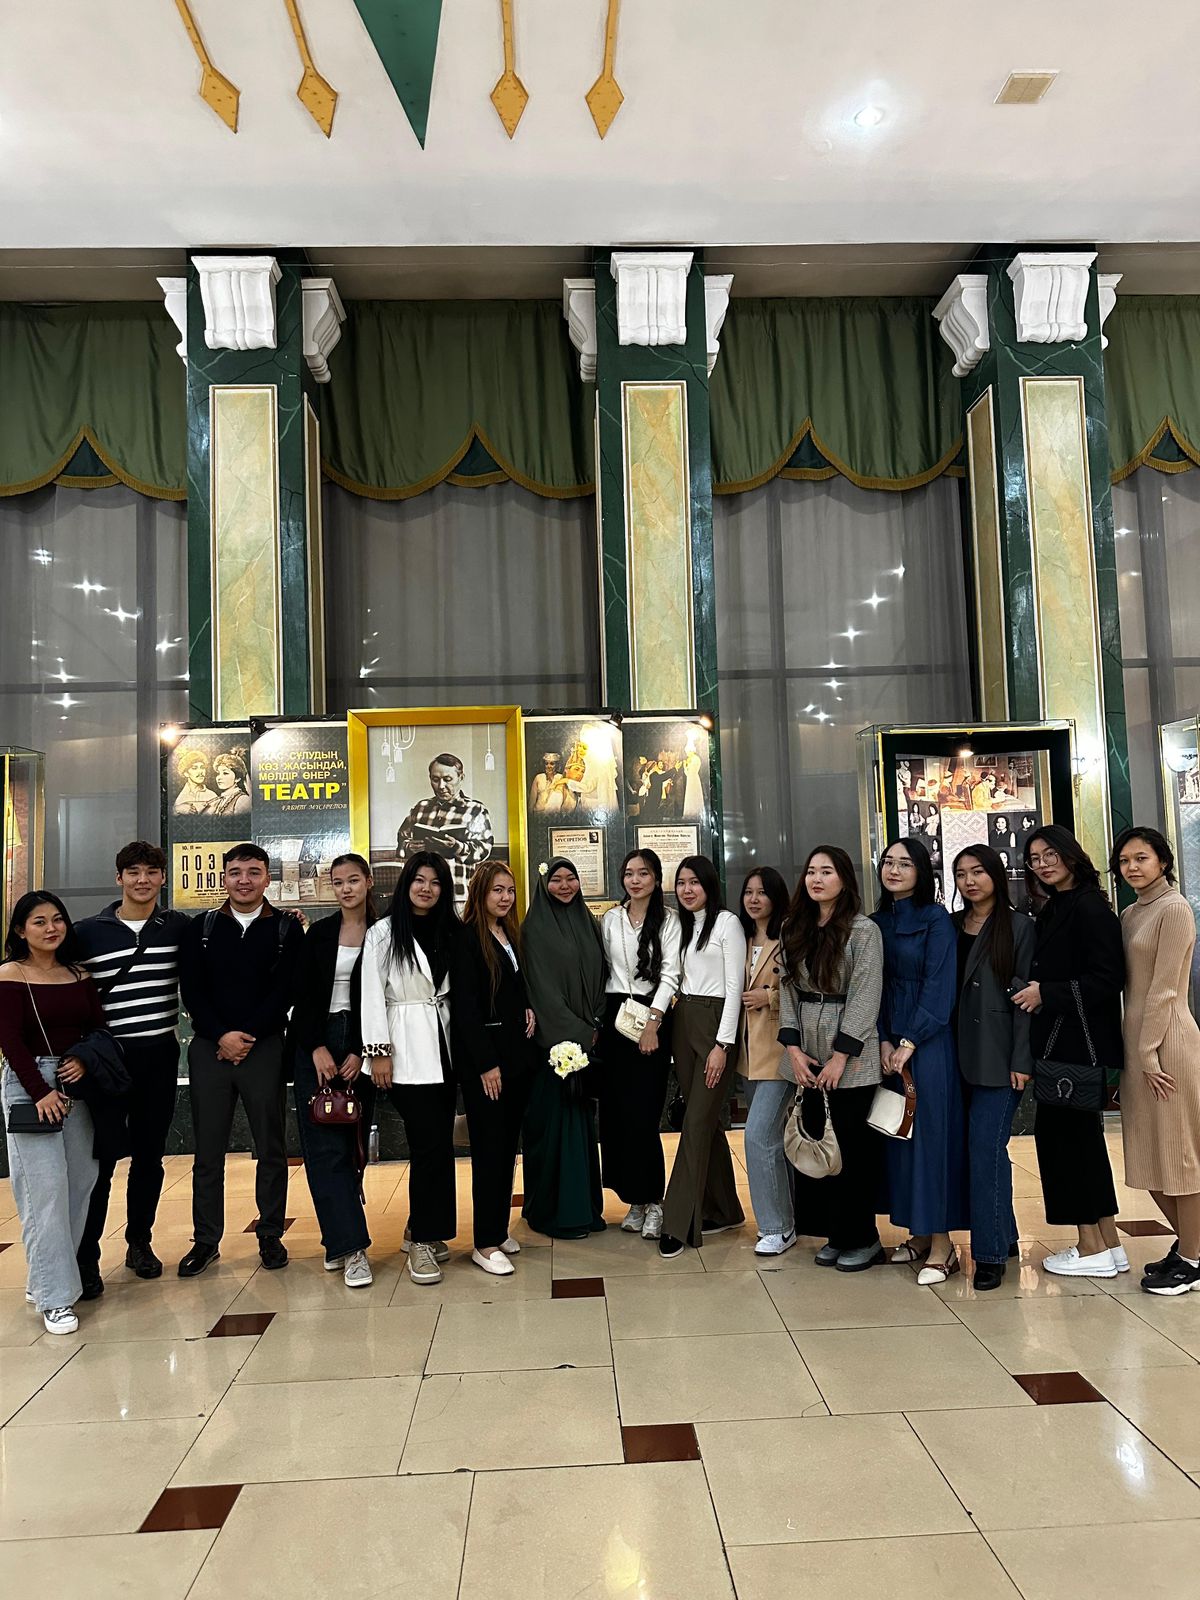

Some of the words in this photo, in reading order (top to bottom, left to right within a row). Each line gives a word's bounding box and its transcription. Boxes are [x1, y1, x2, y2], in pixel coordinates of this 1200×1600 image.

[258, 762, 279, 771] КӨЗ
[284, 759, 347, 770] ЖАСЫНДАЙ,
[302, 771, 331, 780] ӨНЕР
